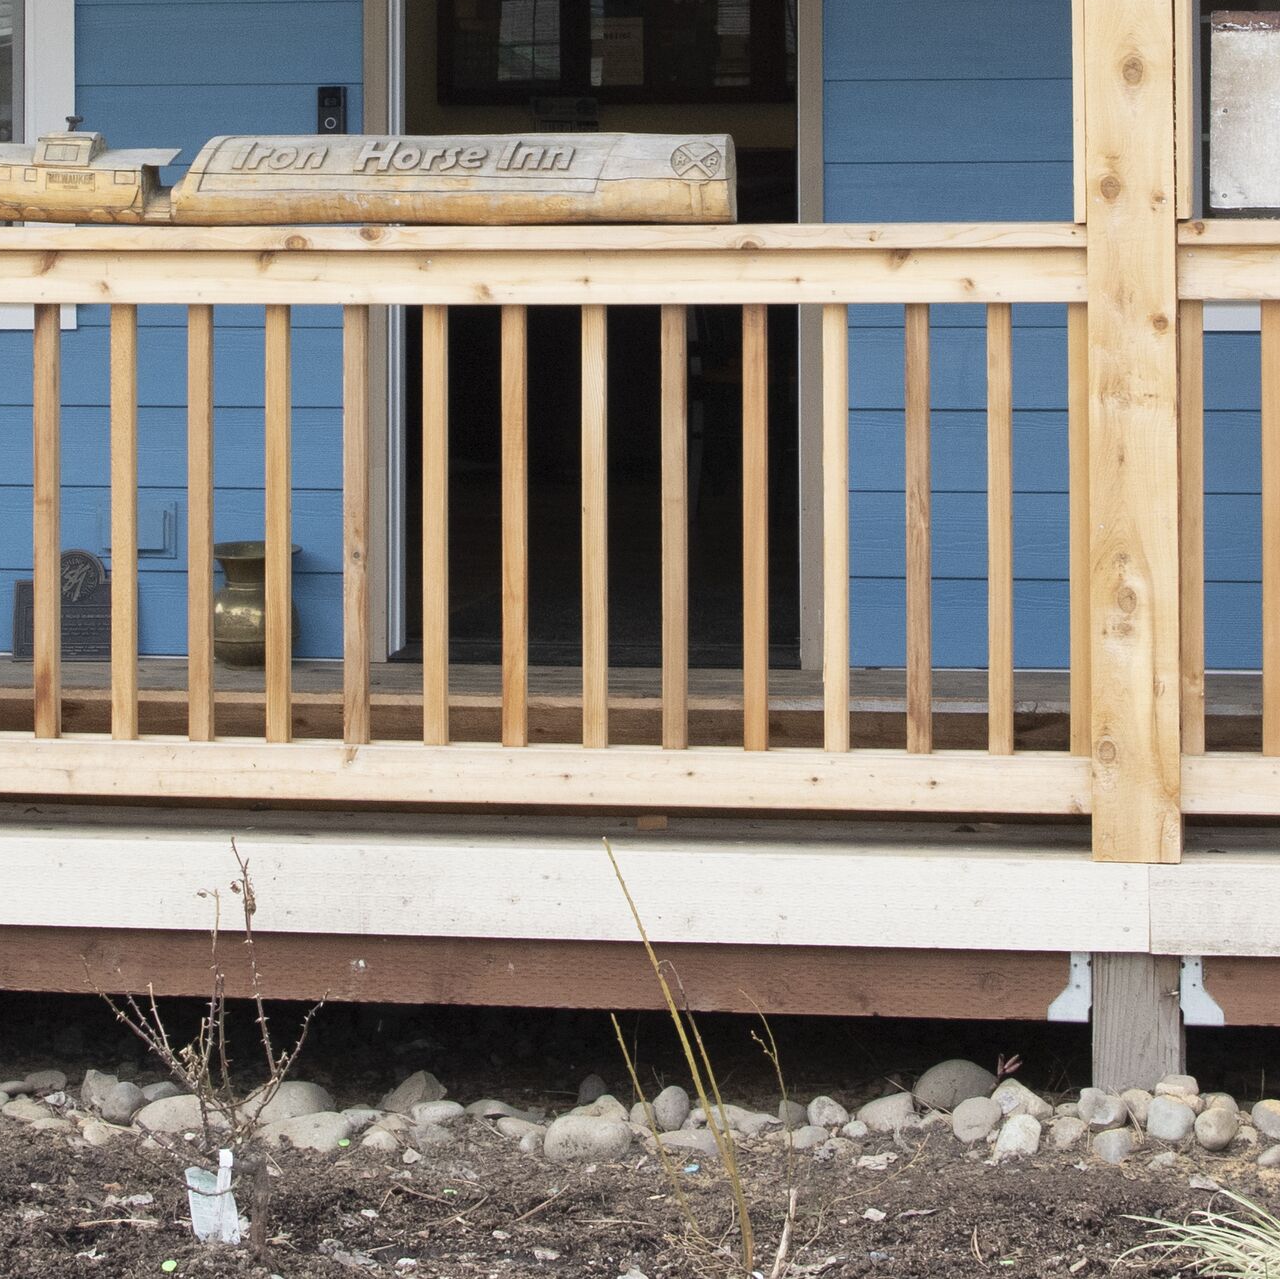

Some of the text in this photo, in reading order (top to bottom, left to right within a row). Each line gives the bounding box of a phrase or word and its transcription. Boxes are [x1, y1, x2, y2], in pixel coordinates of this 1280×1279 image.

[231, 139, 577, 171] Iron Horse Inn
